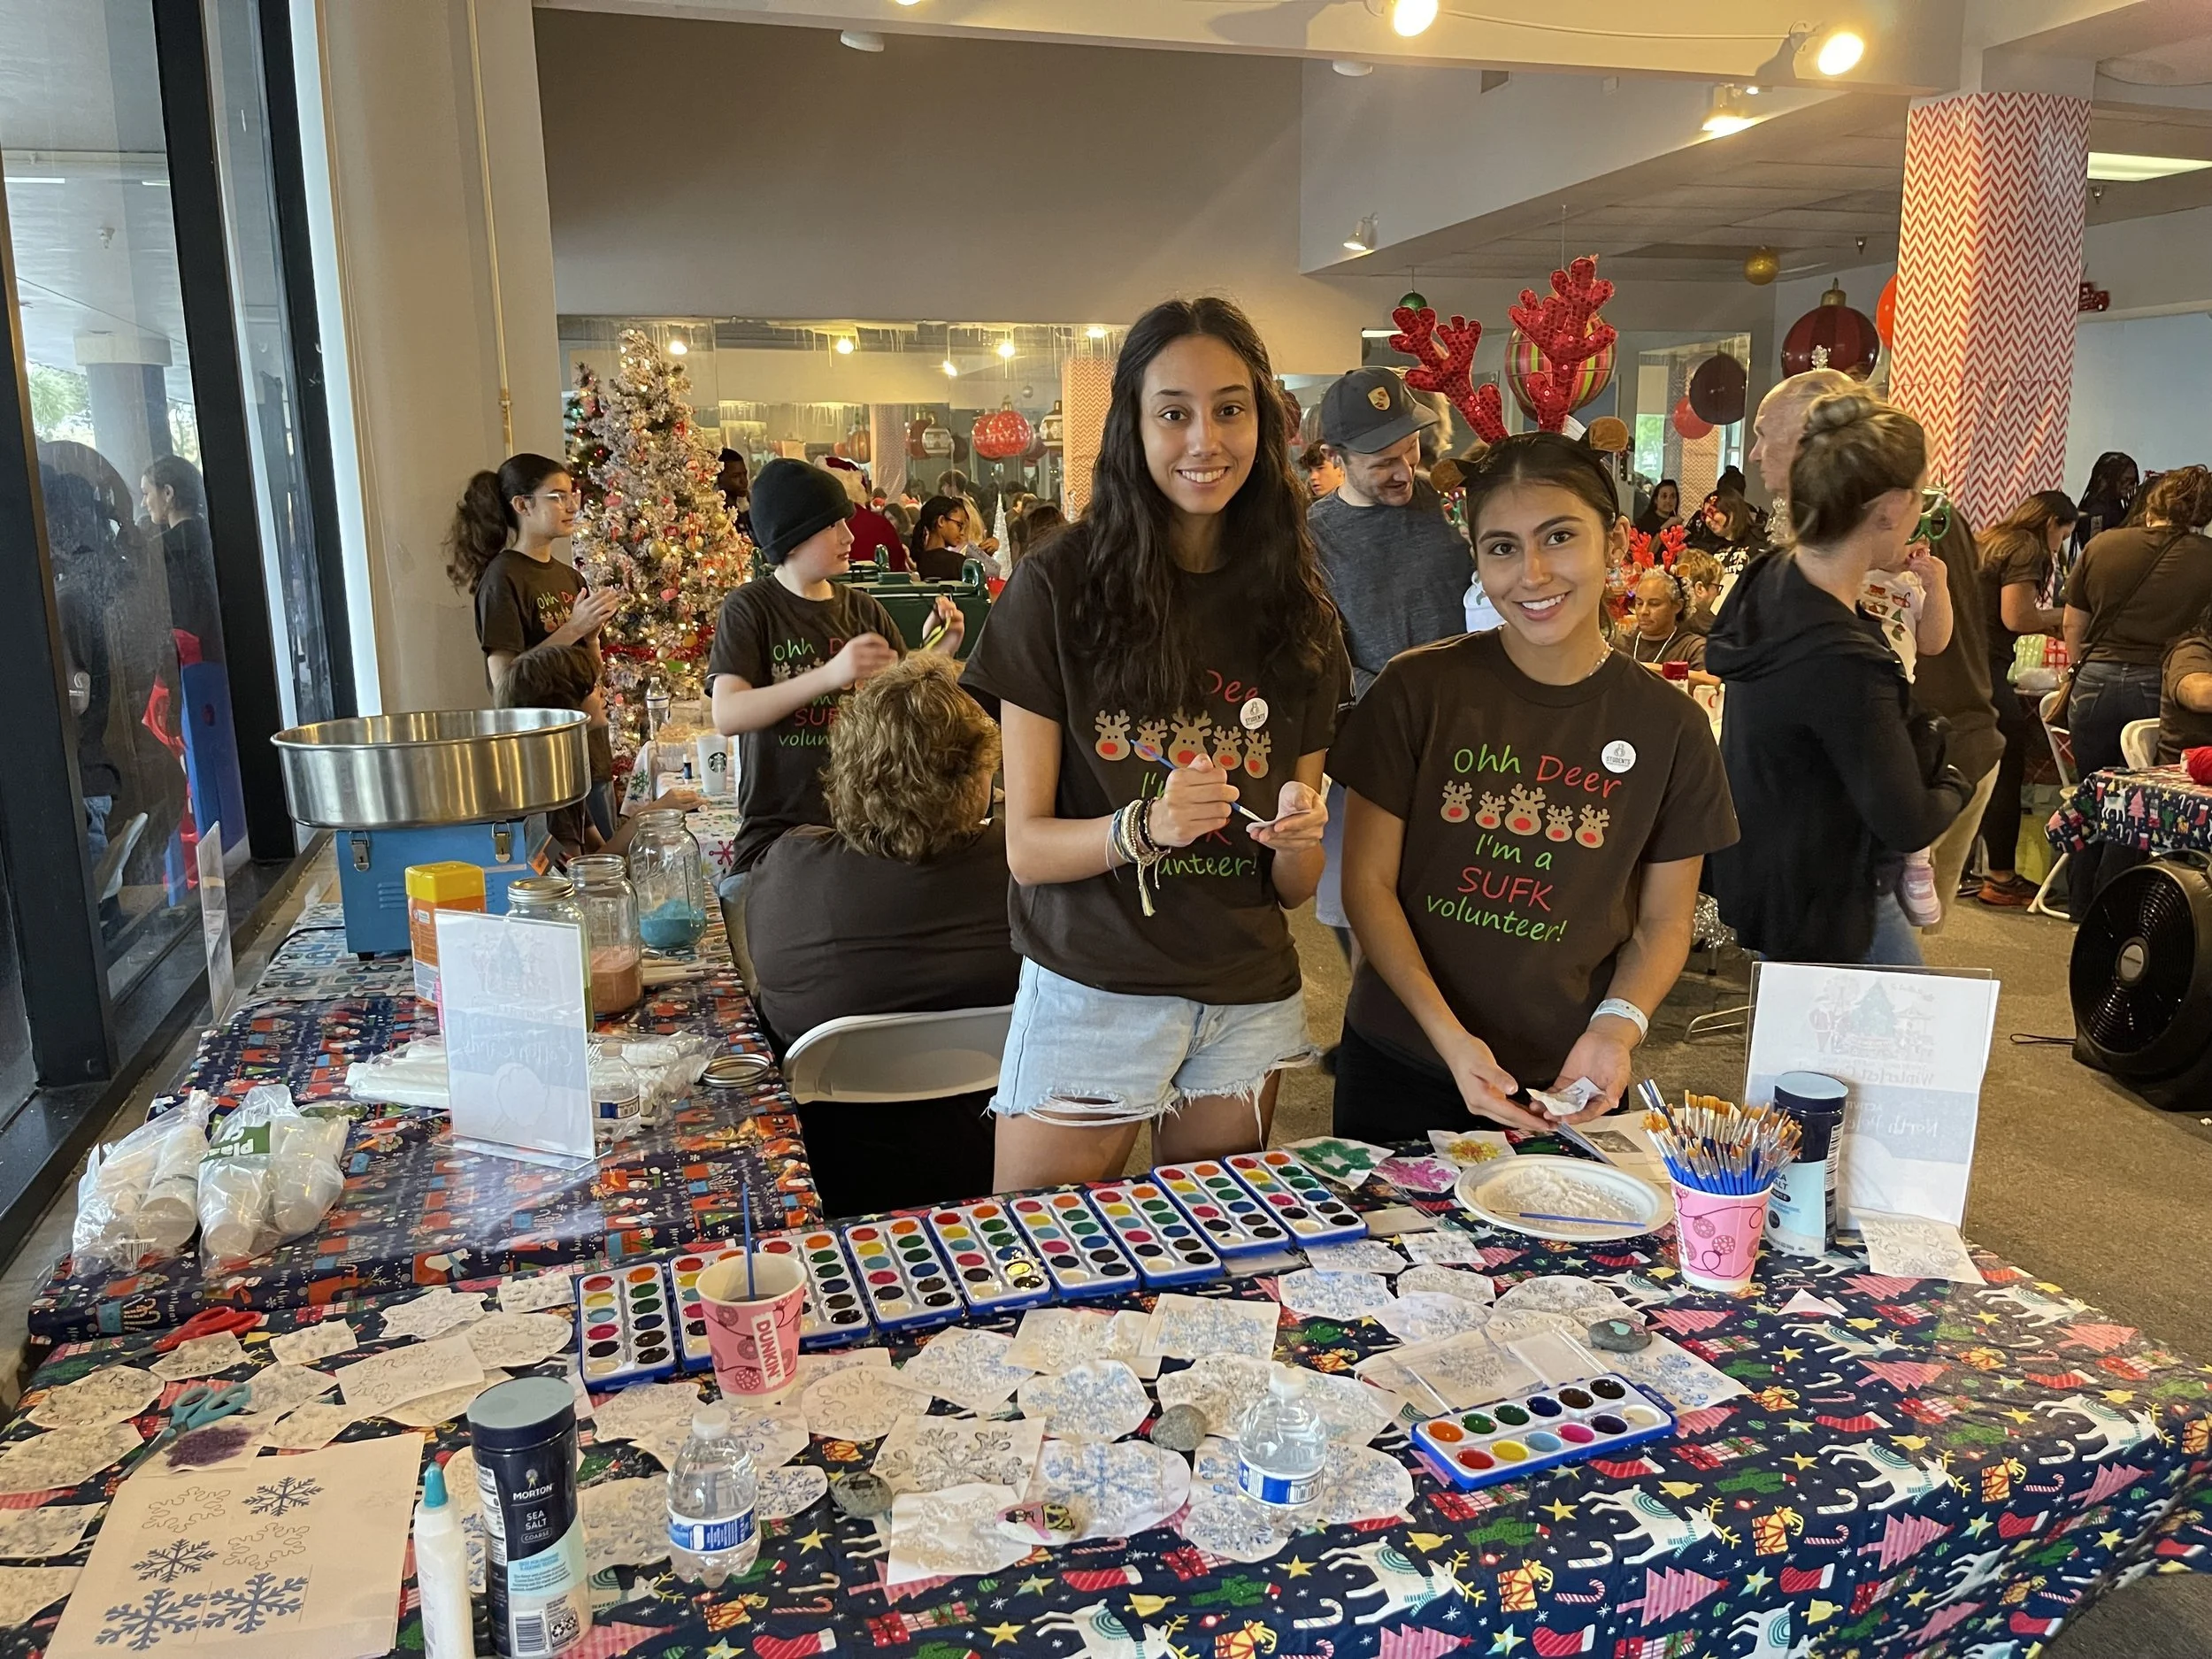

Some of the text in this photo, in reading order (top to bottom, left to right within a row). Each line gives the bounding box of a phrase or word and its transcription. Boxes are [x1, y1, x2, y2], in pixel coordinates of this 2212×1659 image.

[773, 637, 815, 661] Ohh
[795, 709, 841, 726] SUF
[1454, 743, 1622, 798] Ohh Deer
[1475, 833, 1552, 870] I'm a
[1157, 854, 1257, 877] unteer!
[1457, 866, 1553, 911] SUFK
[1426, 895, 1568, 942] volunteer!
[1773, 1179, 1788, 1190] ALT
[513, 1483, 553, 1501] MORTON
[526, 1509, 545, 1521] SEA
[526, 1517, 547, 1531] SALT
[524, 1530, 549, 1541] COARSE
